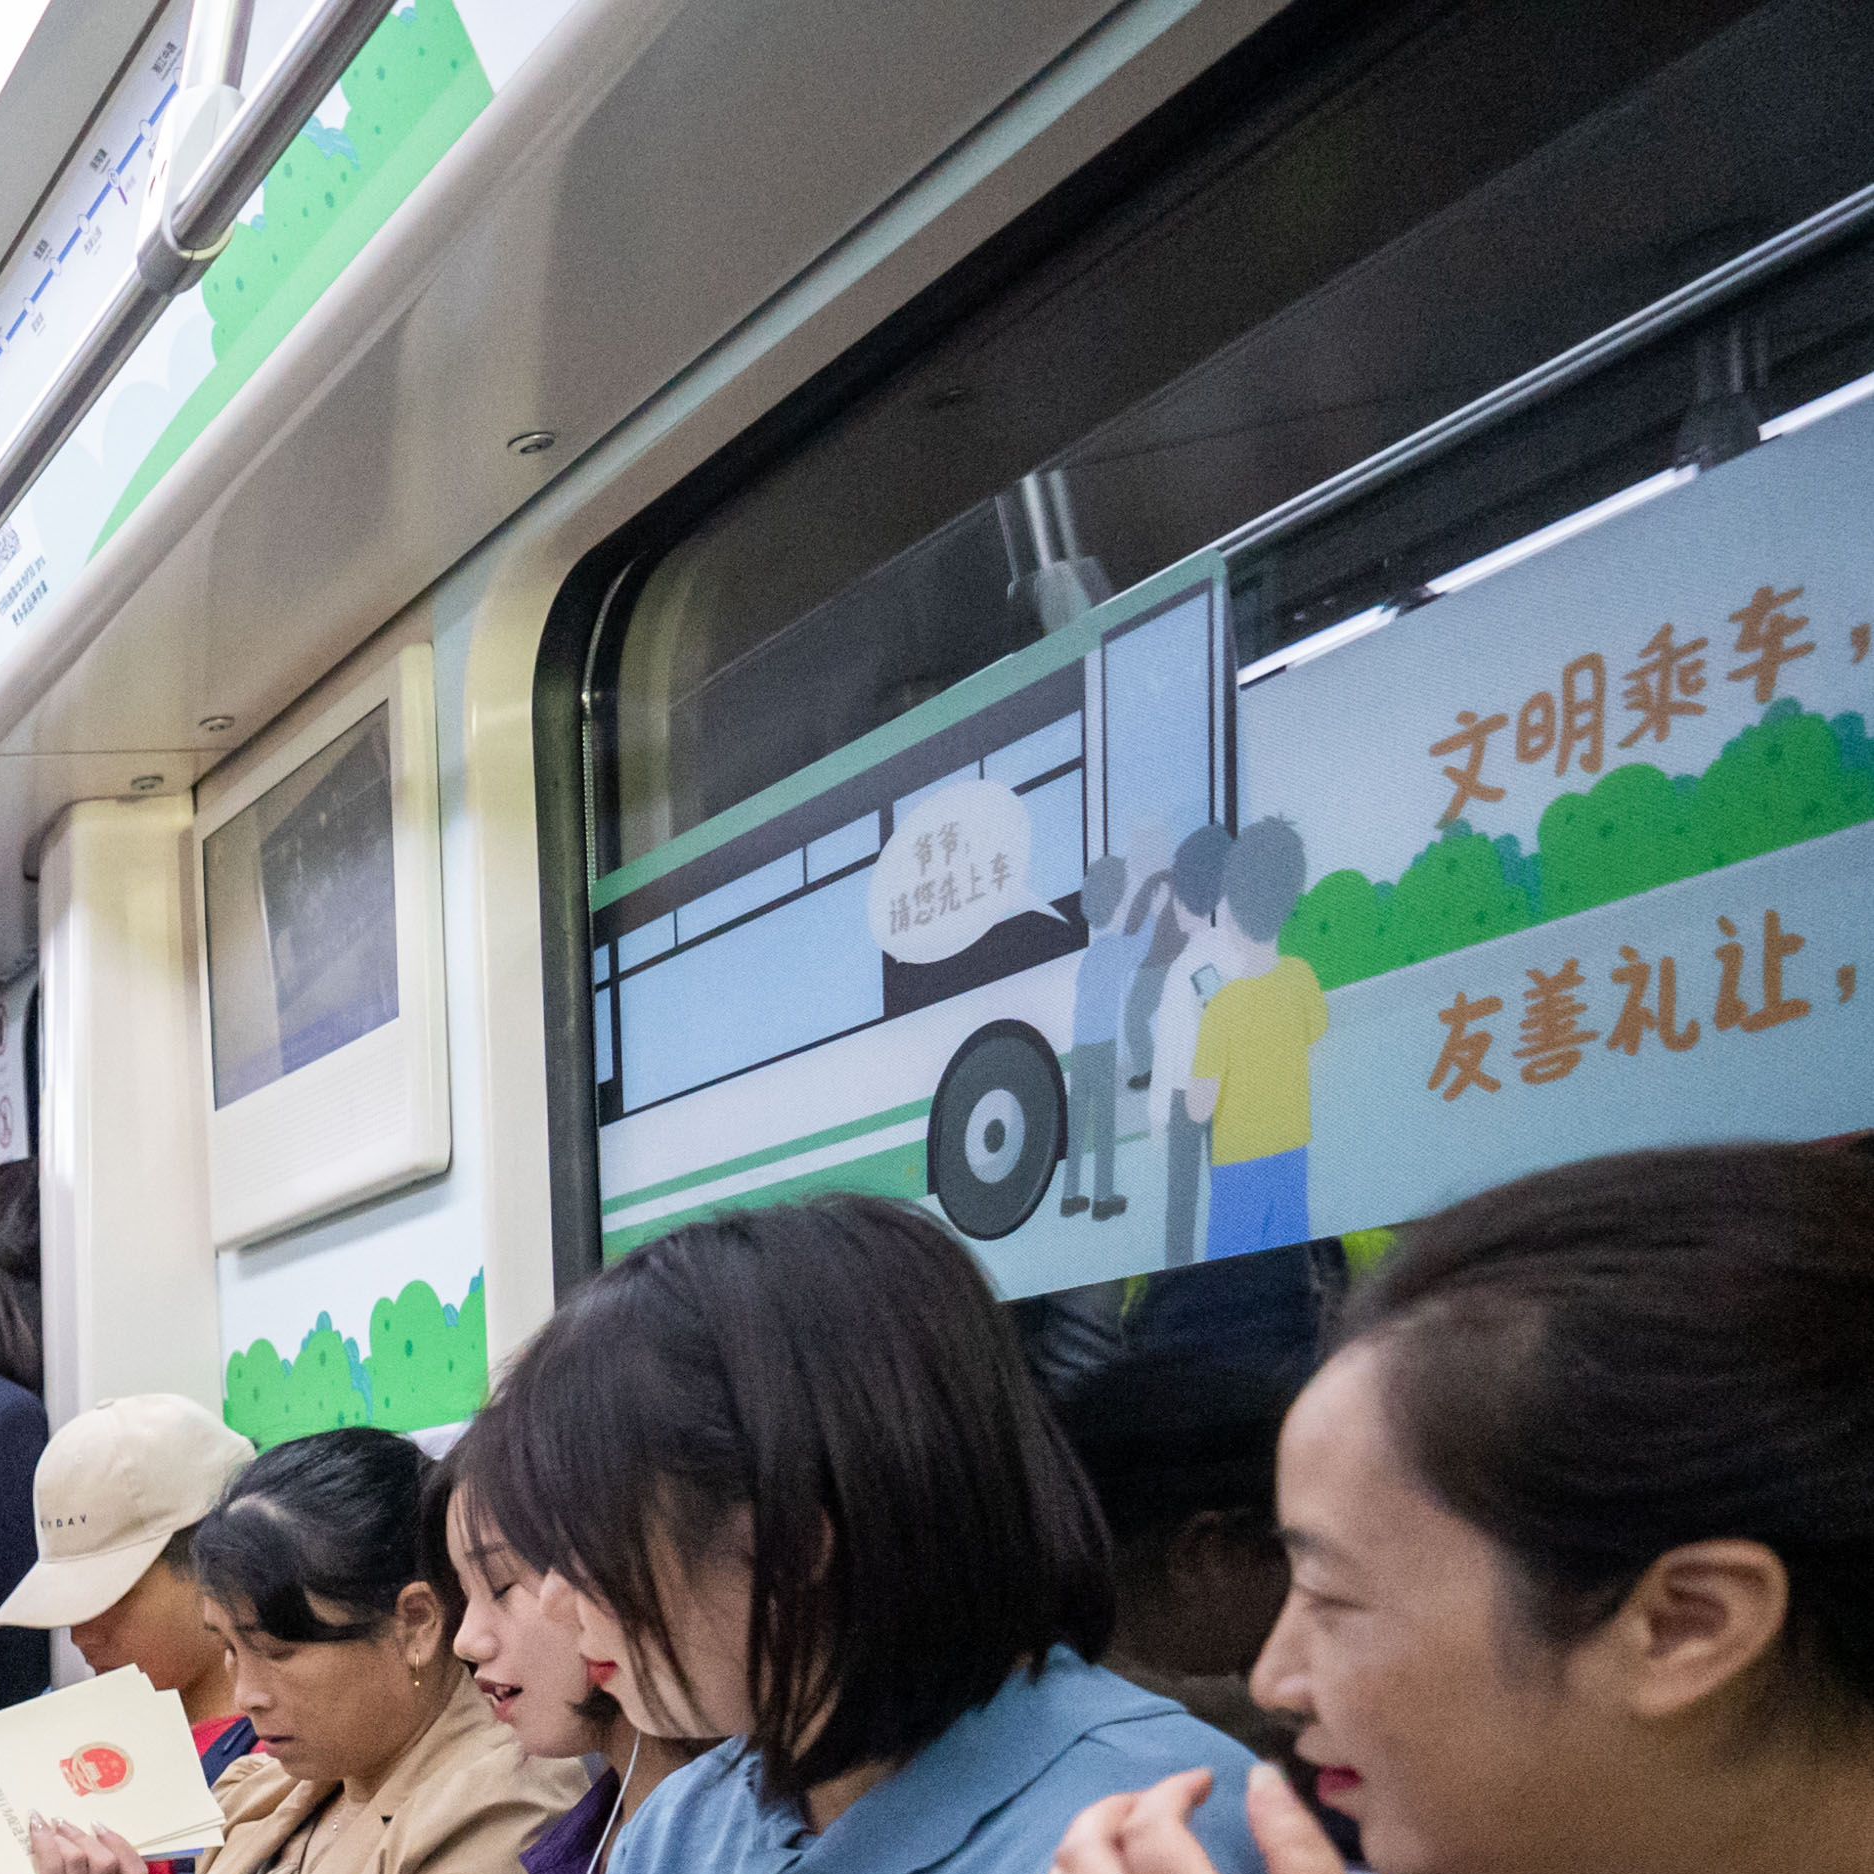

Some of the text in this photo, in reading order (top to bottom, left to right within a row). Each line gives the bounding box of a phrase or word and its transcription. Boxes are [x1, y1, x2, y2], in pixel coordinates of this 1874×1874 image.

[1428, 584, 1872, 828] 文明乘车，
[889, 852, 1012, 935] 请您先上车
[1428, 910, 1859, 1103] 友善礼让，
